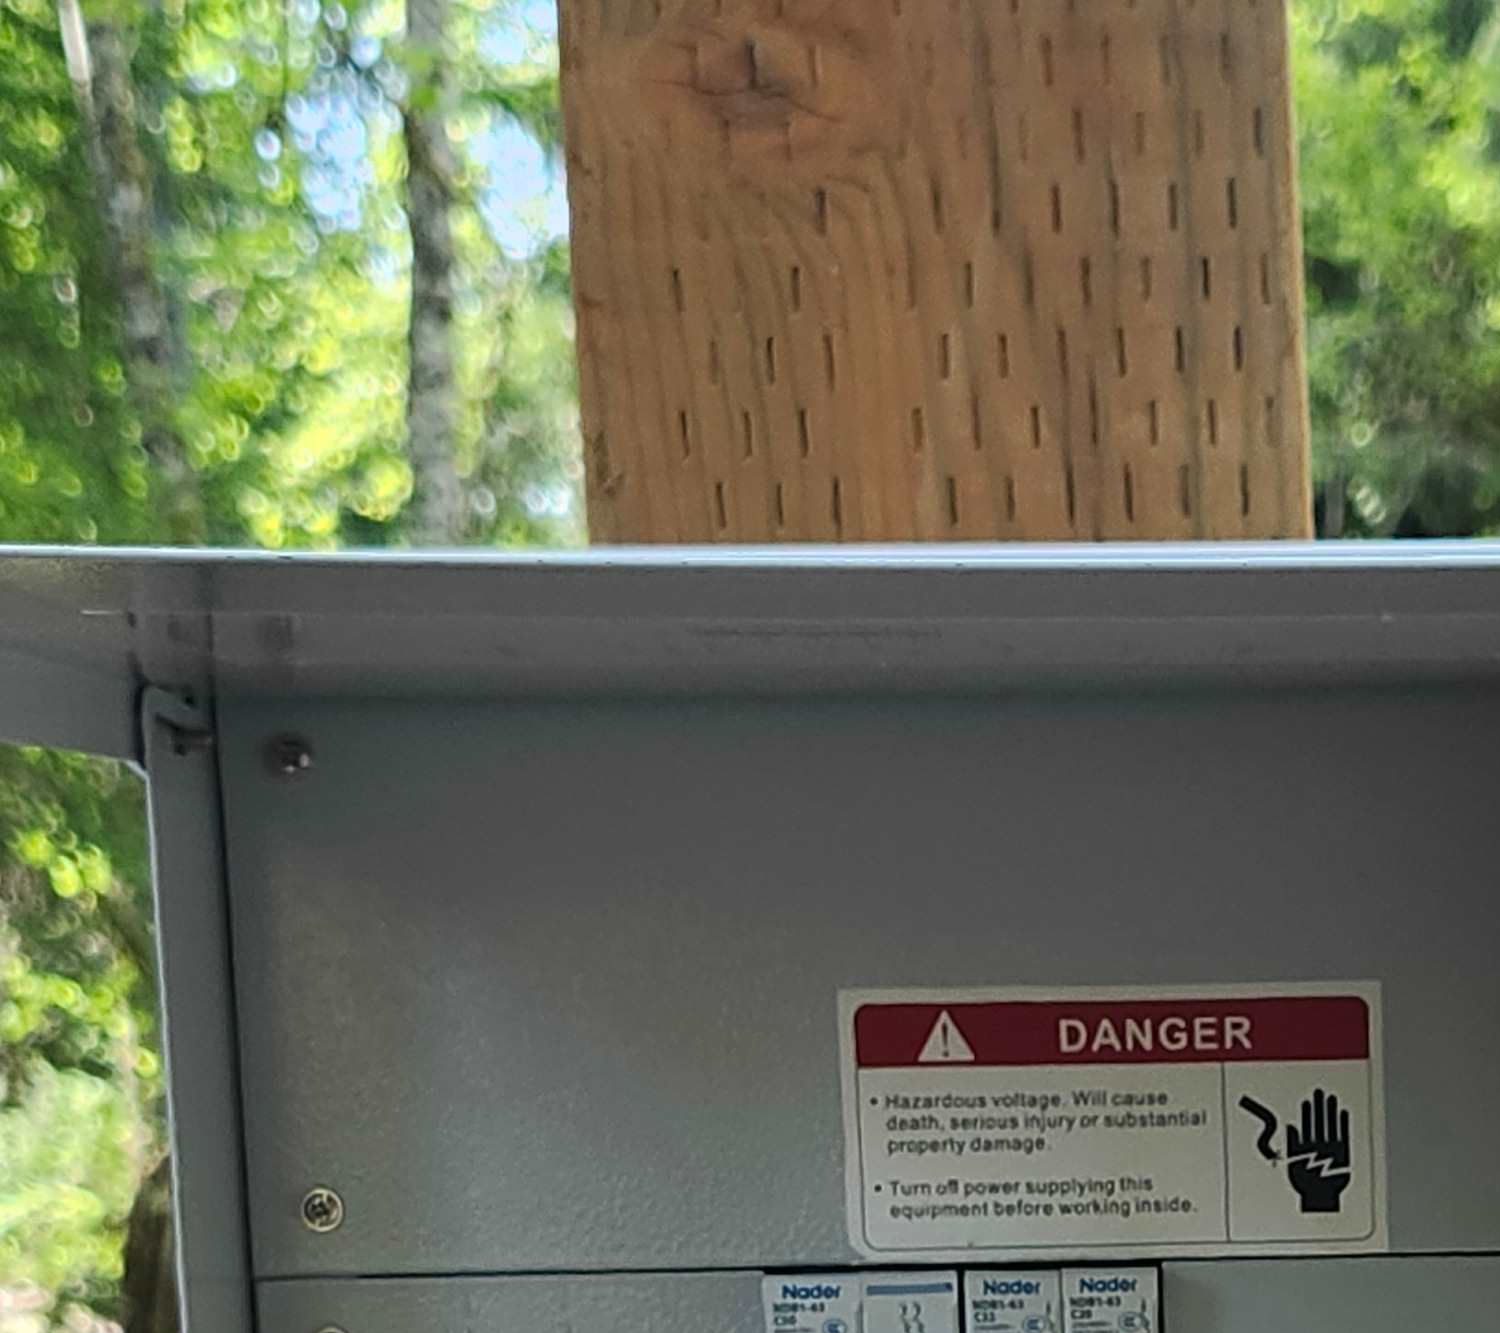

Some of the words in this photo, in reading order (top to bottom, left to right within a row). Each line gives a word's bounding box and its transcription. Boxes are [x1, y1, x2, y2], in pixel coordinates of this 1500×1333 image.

[1059, 1016, 1253, 1052] DANGER
[885, 1093, 987, 1109] Hazardous
[1071, 1089, 1107, 1106] Will
[1111, 1092, 1168, 1106] cause
[886, 1115, 945, 1132] death,
[950, 1114, 1019, 1130] serious
[1024, 1113, 1075, 1133] injury
[1080, 1114, 1098, 1128] or
[1103, 1110, 1207, 1128] substantial
[888, 1138, 965, 1156] property
[890, 1180, 931, 1196] Turn
[936, 1179, 959, 1195] off
[964, 1181, 1021, 1198] power
[1025, 1178, 1115, 1197] supplying
[1120, 1177, 1153, 1191] this
[890, 1202, 989, 1220] equipment
[993, 1200, 1053, 1216] before
[1058, 1198, 1131, 1218] working
[1135, 1197, 1198, 1213] inside.
[782, 1284, 841, 1300] Nader
[983, 1279, 1041, 1296] Nader
[1080, 1277, 1137, 1294] Nader
